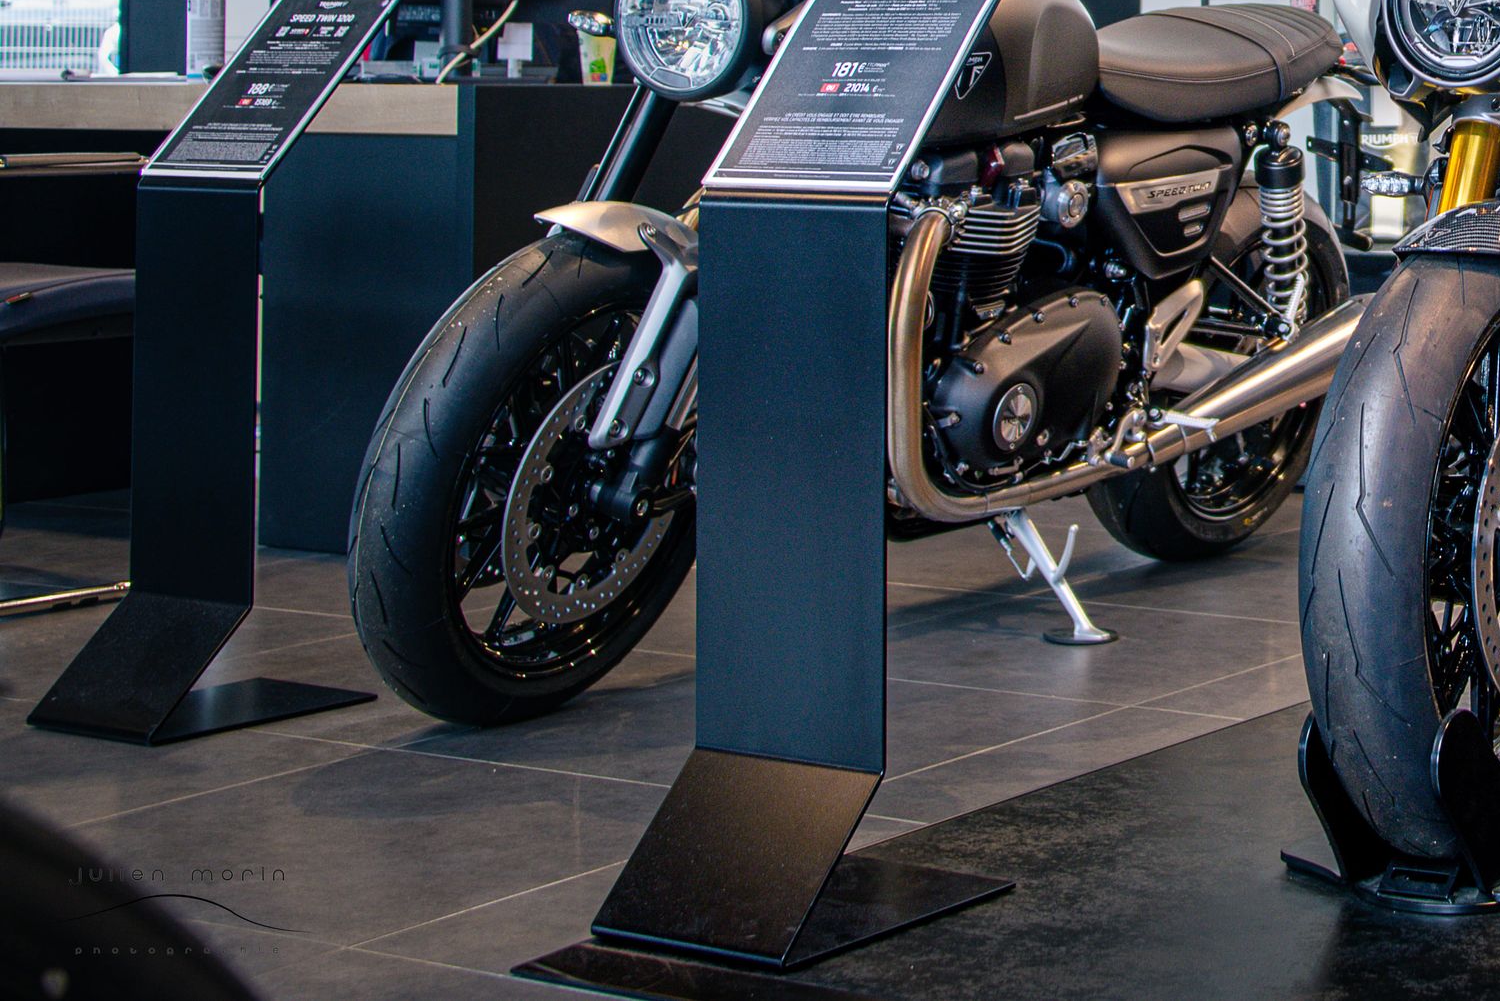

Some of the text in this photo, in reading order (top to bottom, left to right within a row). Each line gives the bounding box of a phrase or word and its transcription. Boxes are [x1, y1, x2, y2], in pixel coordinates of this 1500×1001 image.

[290, 14, 317, 23] SPEED
[316, 14, 337, 23] TWIN
[844, 82, 869, 93] 21014
[1361, 134, 1409, 149] RIUMPH
[1147, 187, 1186, 199] SPEED
